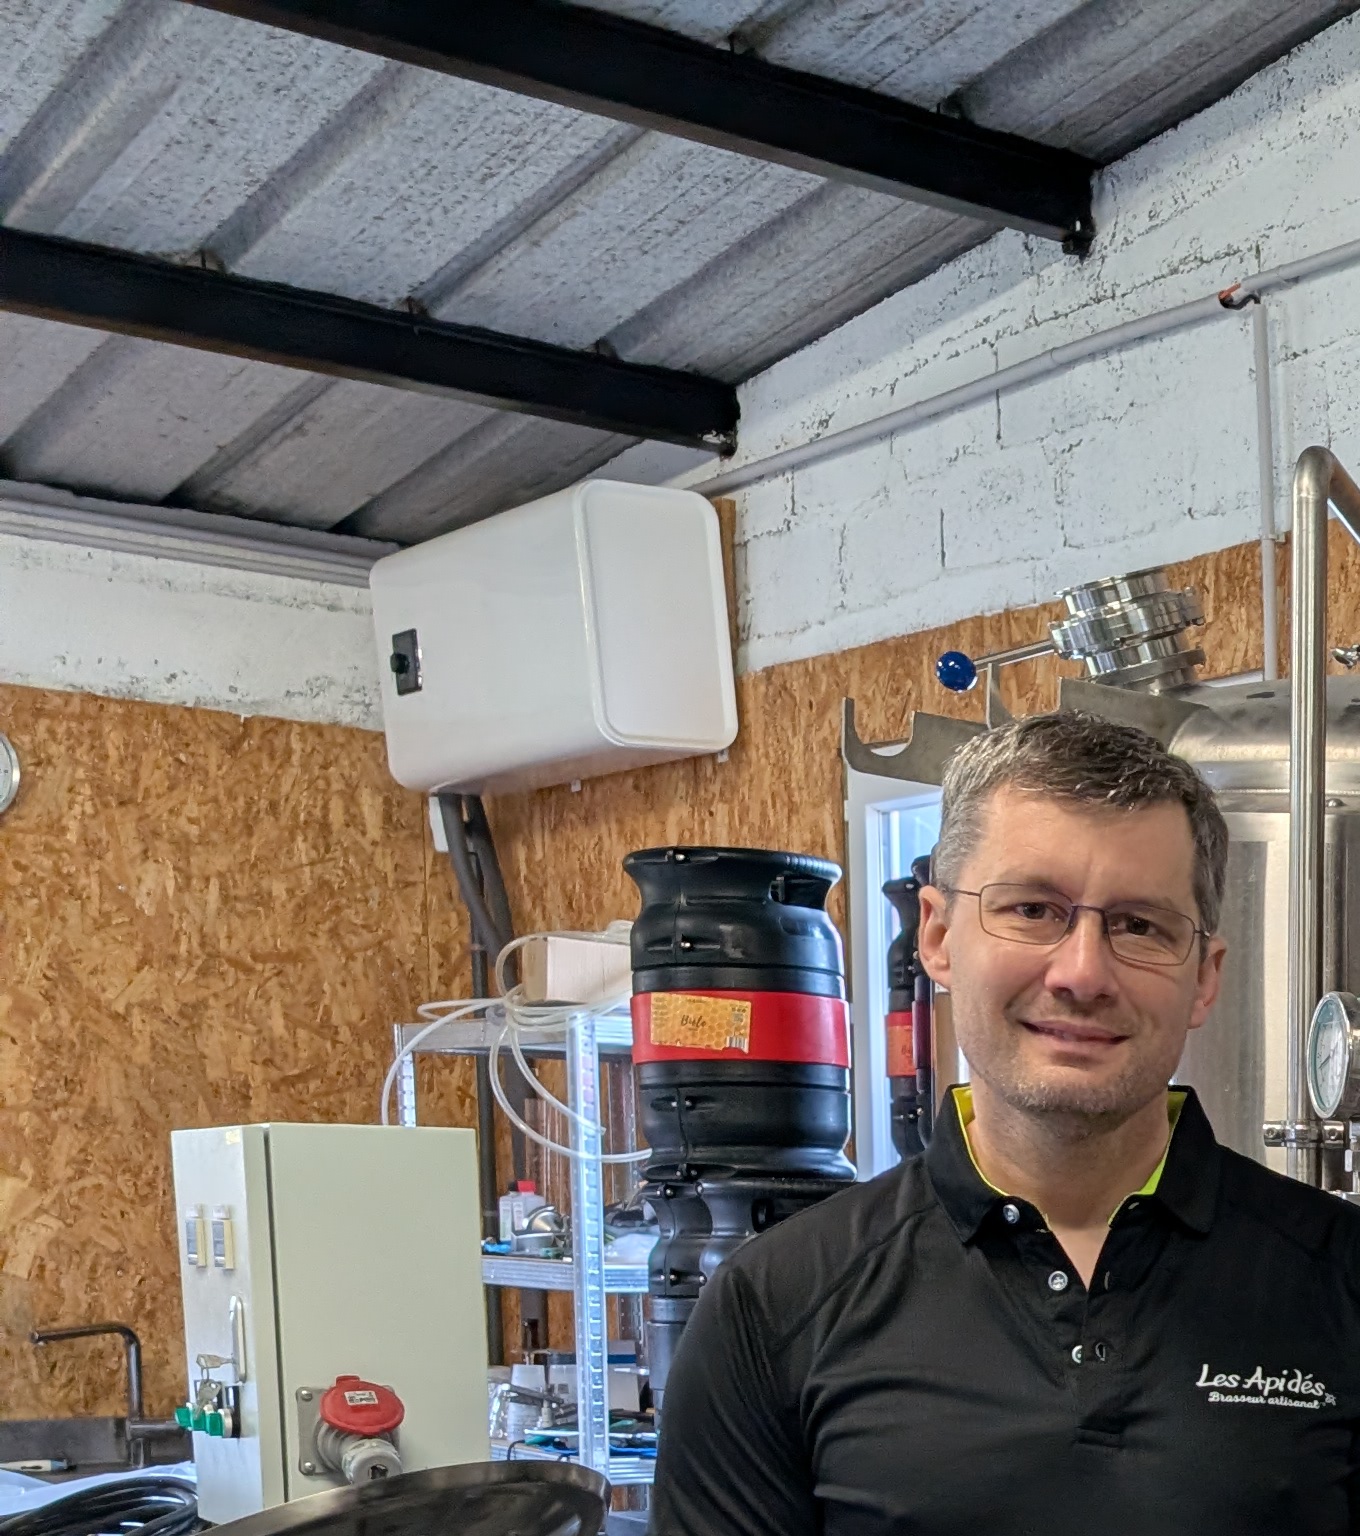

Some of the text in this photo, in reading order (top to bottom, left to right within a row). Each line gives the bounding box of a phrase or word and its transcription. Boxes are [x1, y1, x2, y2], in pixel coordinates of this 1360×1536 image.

[1196, 1364, 1326, 1397] Les Apidés
[1208, 1391, 1321, 1410] Brasseur artisanal
